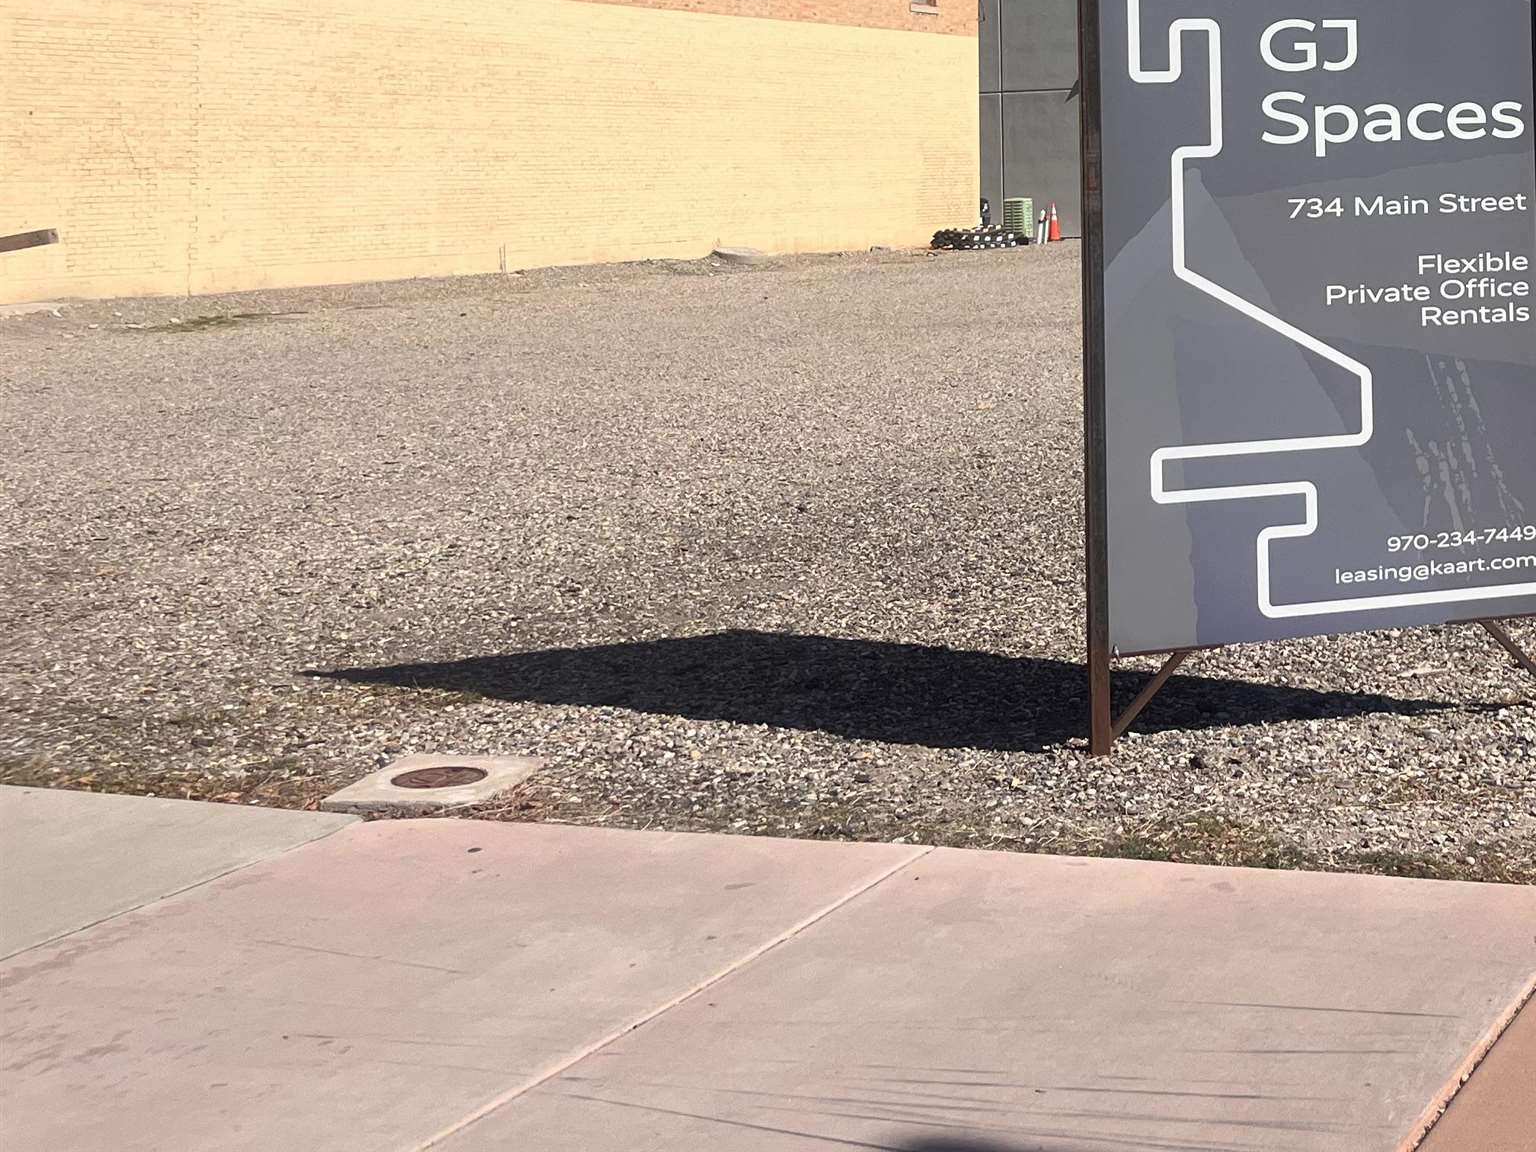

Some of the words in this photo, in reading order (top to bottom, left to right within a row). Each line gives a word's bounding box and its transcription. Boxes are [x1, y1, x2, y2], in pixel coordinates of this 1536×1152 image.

[1259, 18, 1358, 72] GJ
[1261, 90, 1525, 157] Spaces
[1288, 198, 1344, 218] 734
[1354, 195, 1429, 217] Main
[1439, 192, 1527, 214] Street
[1418, 251, 1529, 275] Flexible
[1326, 284, 1430, 305] Private
[1440, 278, 1529, 300] Office
[1421, 303, 1530, 326] Rentals
[1387, 525, 1536, 552] 970-234-7449
[1335, 554, 1536, 584] leasing@kaart.com
